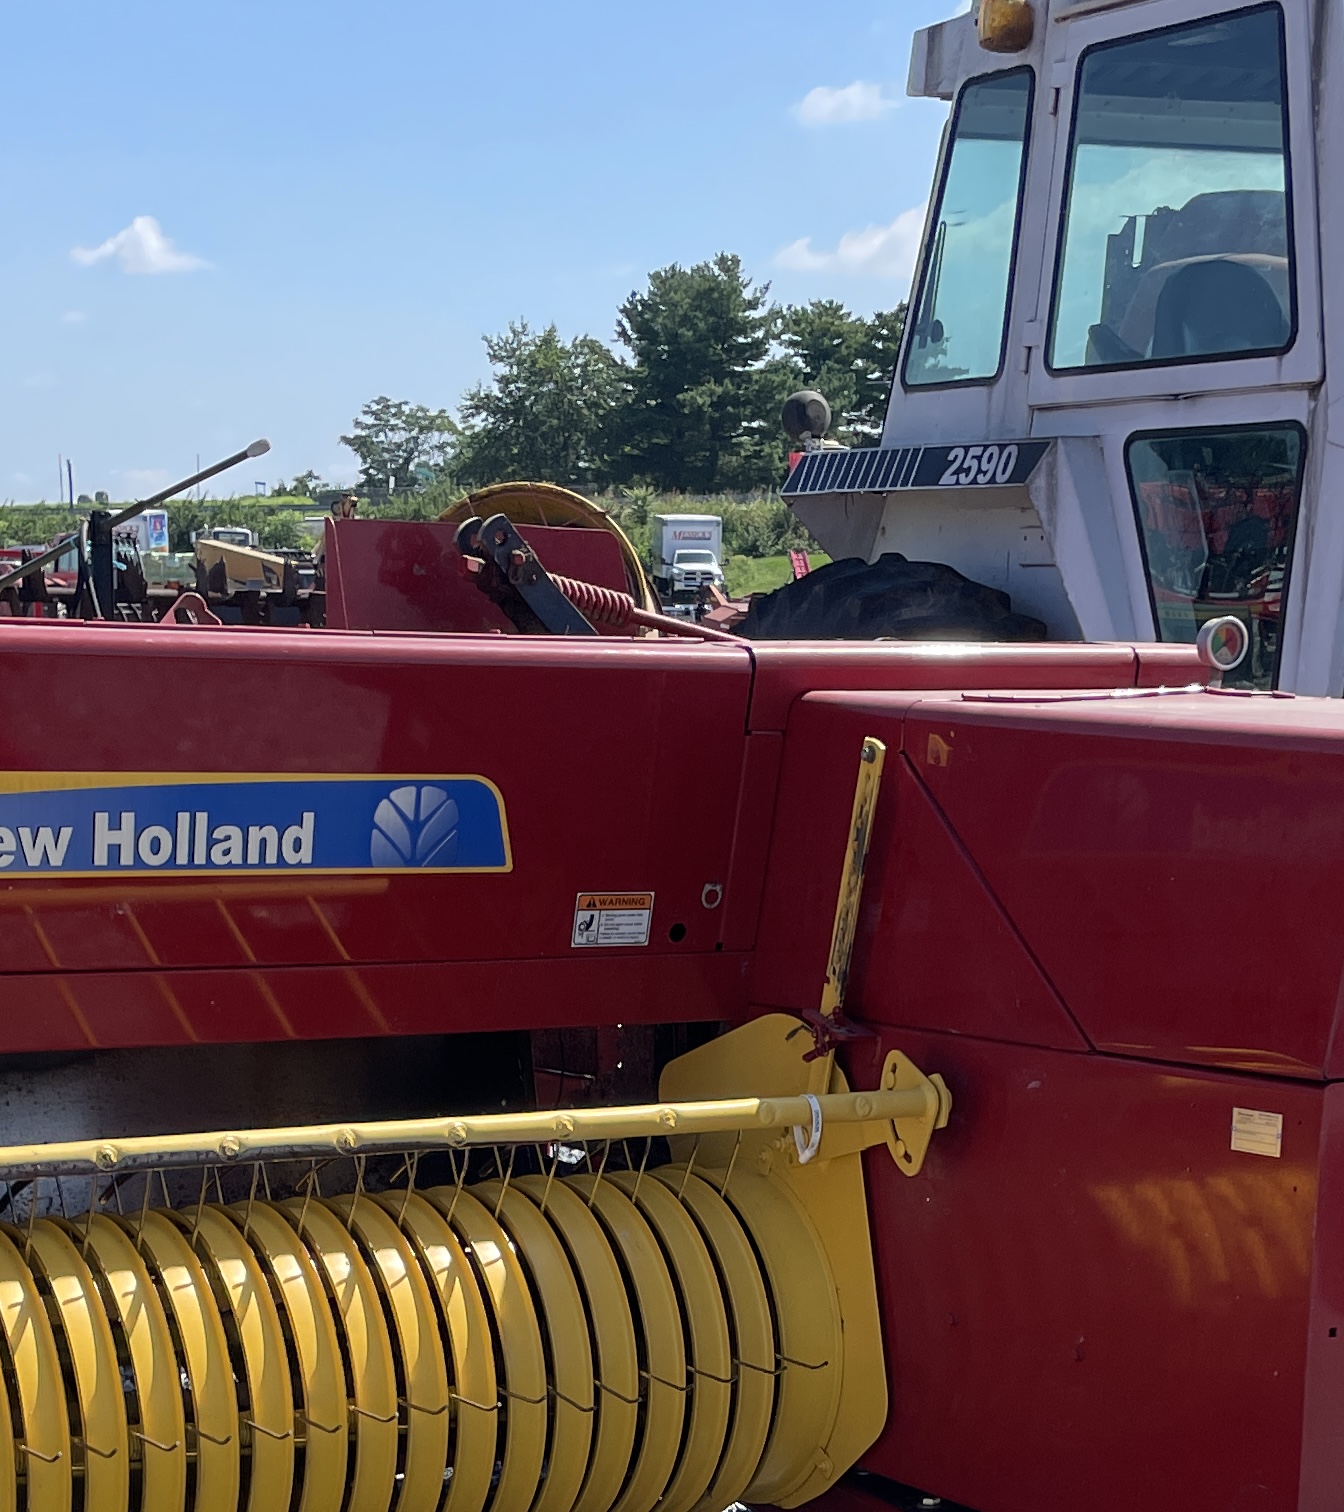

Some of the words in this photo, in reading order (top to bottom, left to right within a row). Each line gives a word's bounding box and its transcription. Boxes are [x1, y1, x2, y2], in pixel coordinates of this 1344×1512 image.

[938, 444, 1019, 485] 2590
[92, 811, 316, 867] Holland
[598, 897, 646, 906] WARNING
